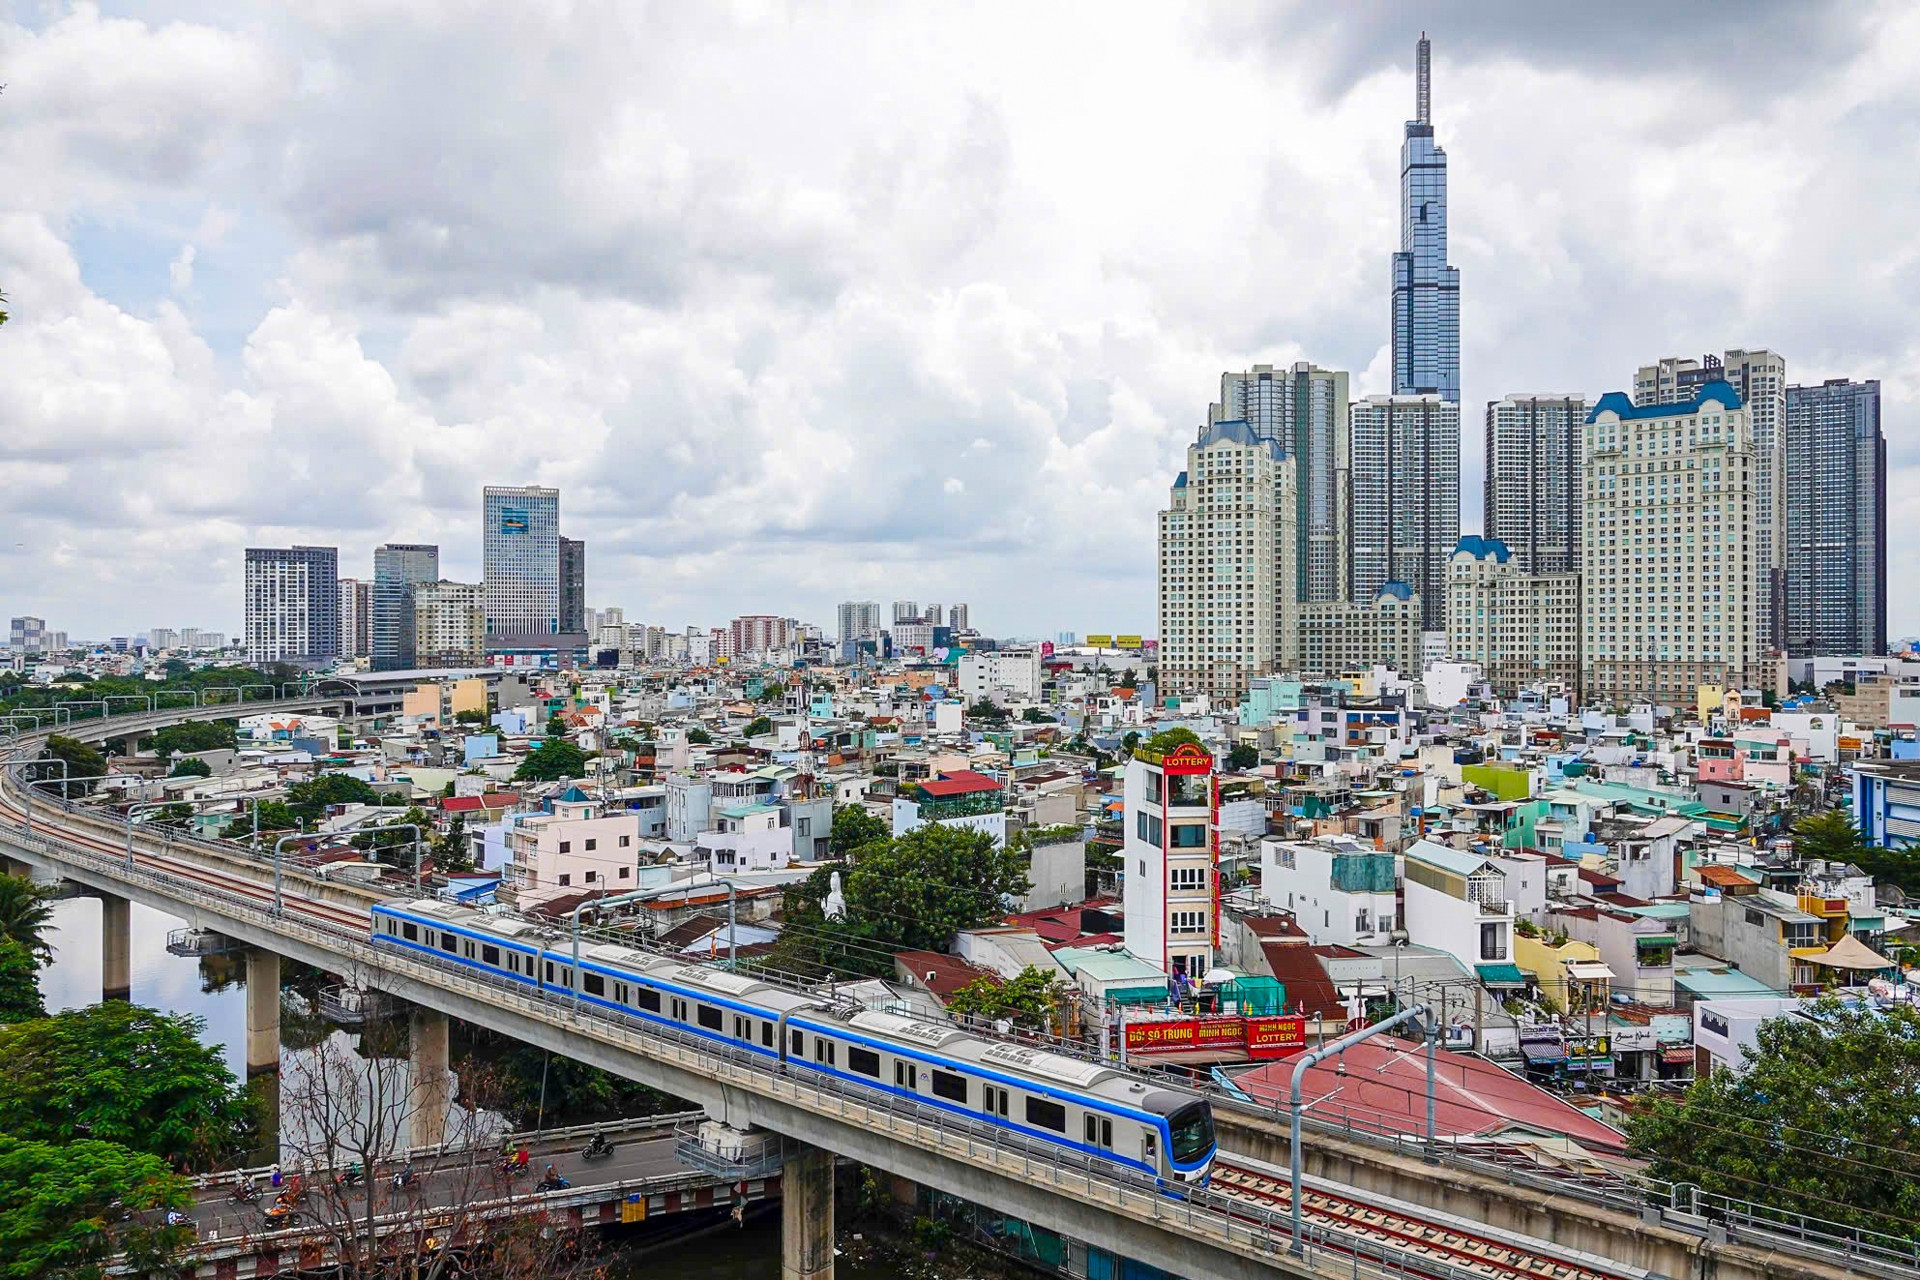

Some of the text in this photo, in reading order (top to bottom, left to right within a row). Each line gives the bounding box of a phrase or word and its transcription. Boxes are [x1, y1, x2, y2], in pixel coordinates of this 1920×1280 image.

[1166, 758, 1209, 766] LOTTERY
[1199, 1029, 1220, 1037] MINH
[1256, 1033, 1297, 1043] LOTTERY
